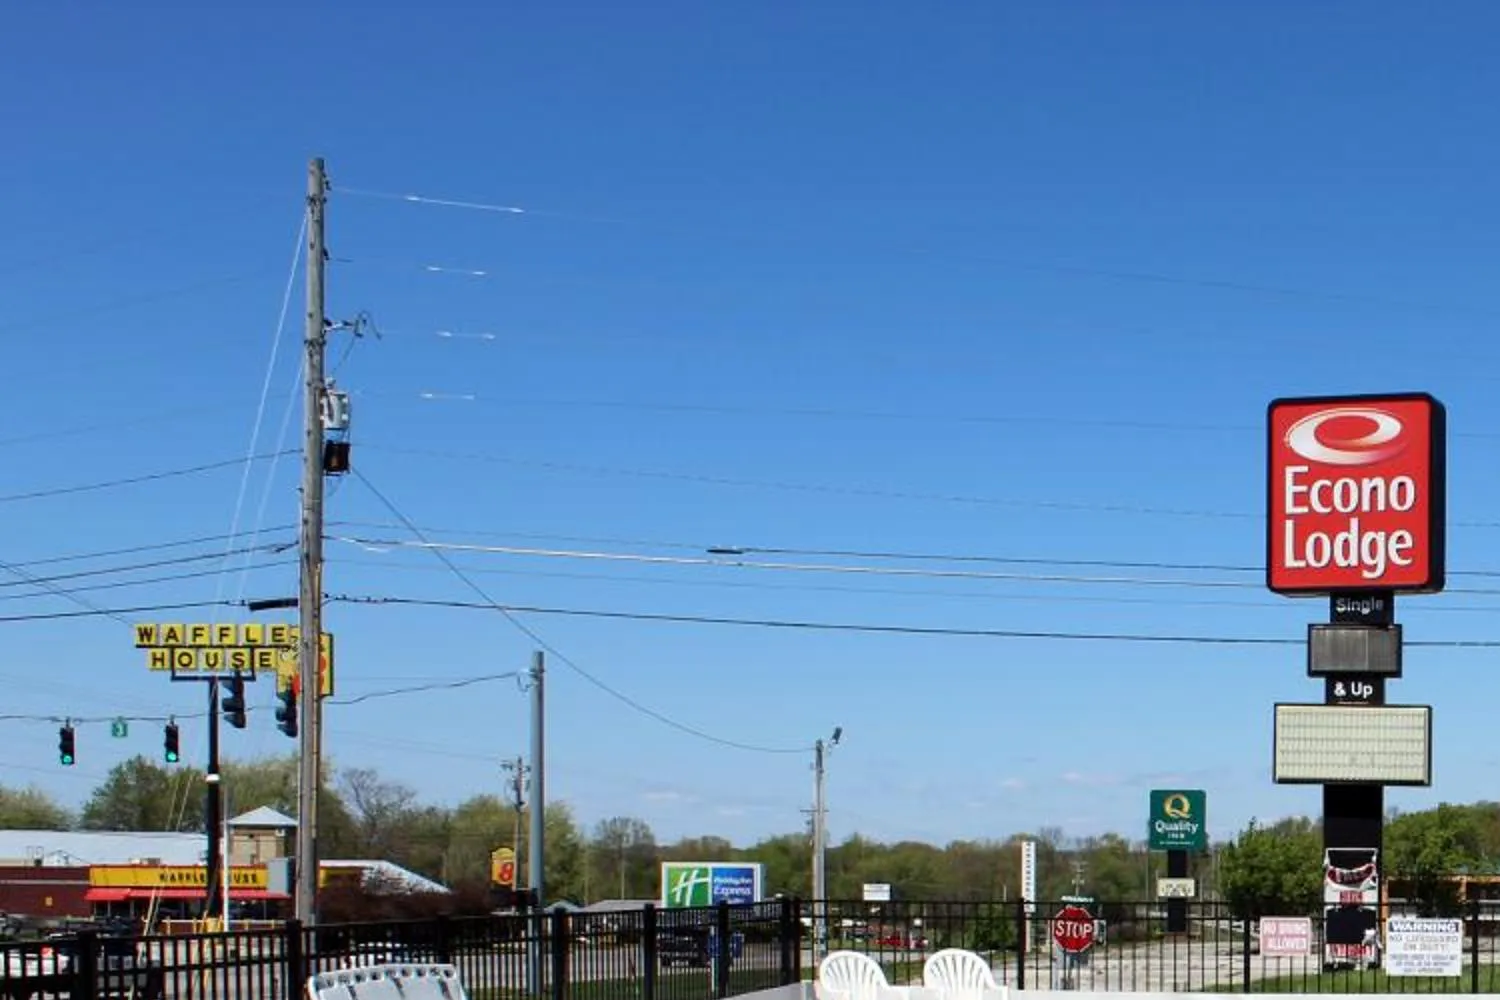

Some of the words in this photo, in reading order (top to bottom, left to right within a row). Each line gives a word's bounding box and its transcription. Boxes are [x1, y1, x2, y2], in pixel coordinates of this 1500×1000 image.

[1285, 465, 1415, 514] Econo
[1285, 517, 1413, 579] Lodge
[1336, 596, 1384, 615] Single
[137, 627, 285, 643] WAFFLE
[152, 652, 272, 667] HOUSE
[1334, 682, 1346, 696] &
[1351, 682, 1373, 699] Up
[1155, 819, 1199, 835] Quality
[713, 884, 752, 898] Express
[1055, 920, 1093, 938] STOP
[1391, 921, 1458, 932] WARNING
